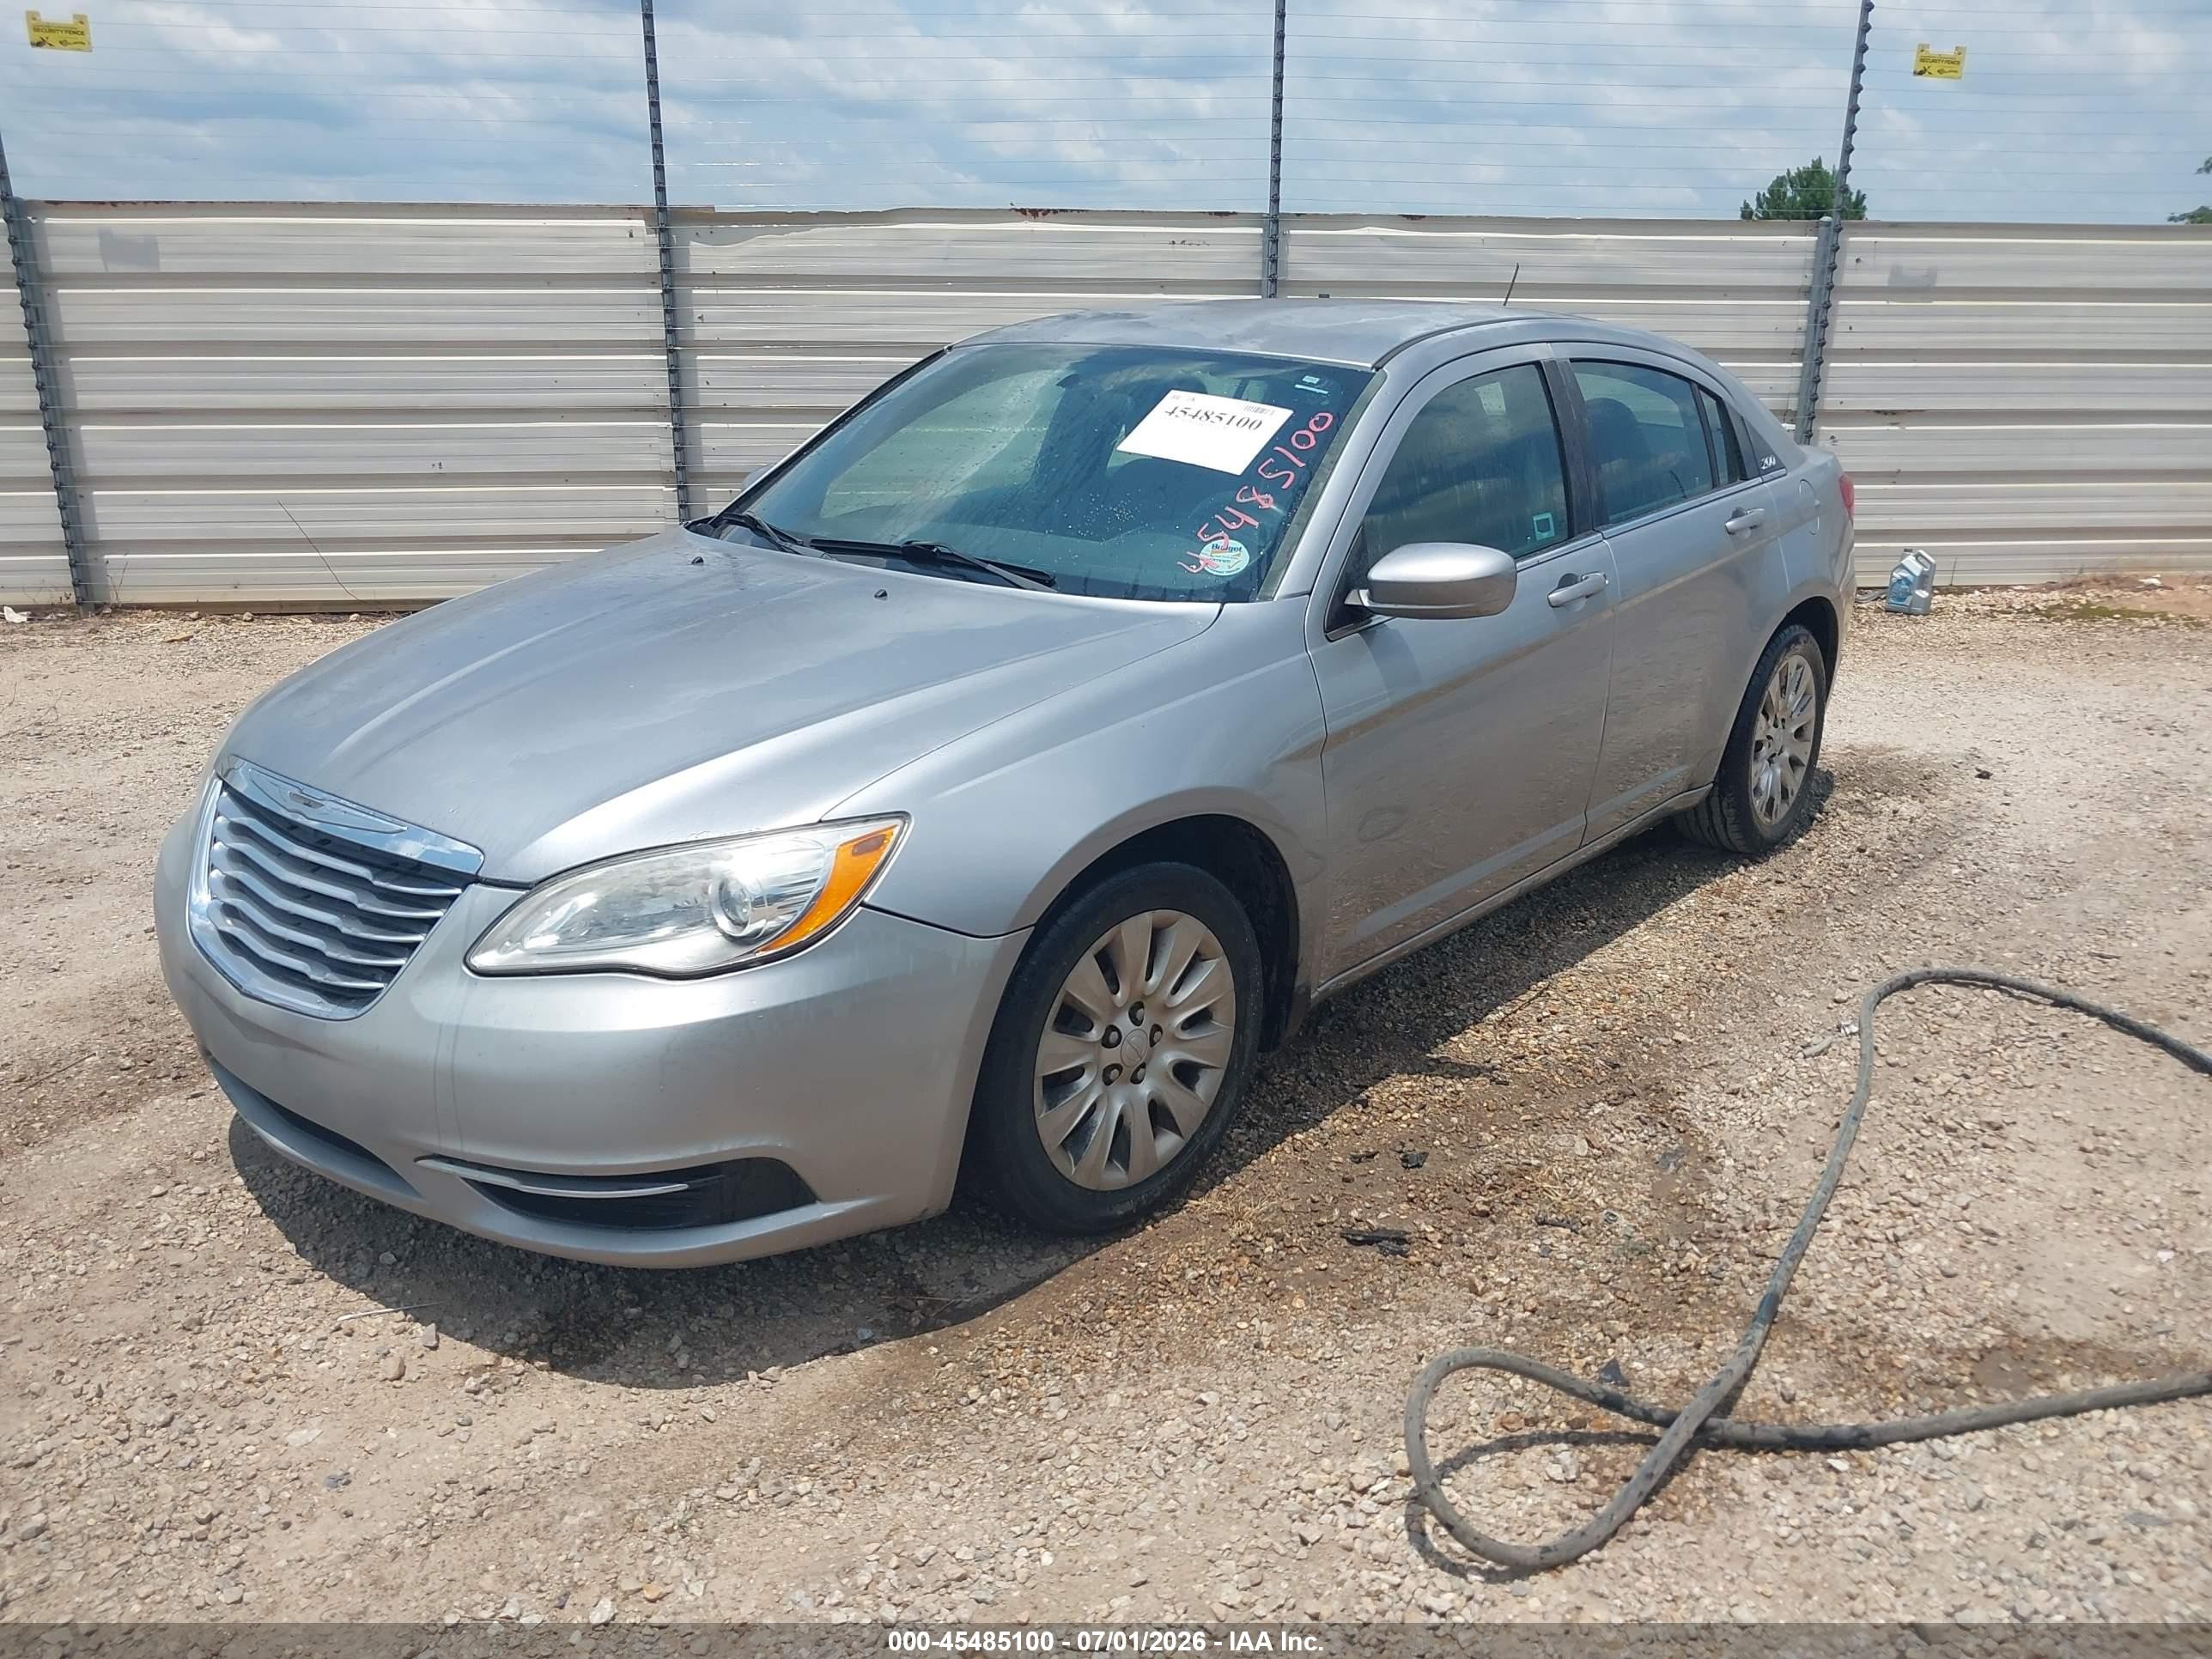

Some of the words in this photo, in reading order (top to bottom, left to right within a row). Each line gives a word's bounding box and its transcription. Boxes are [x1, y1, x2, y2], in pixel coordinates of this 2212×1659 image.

[33, 27, 64, 35] SECURITY
[1164, 405, 1263, 431] 45485100
[1176, 412, 1334, 573] 45485100
